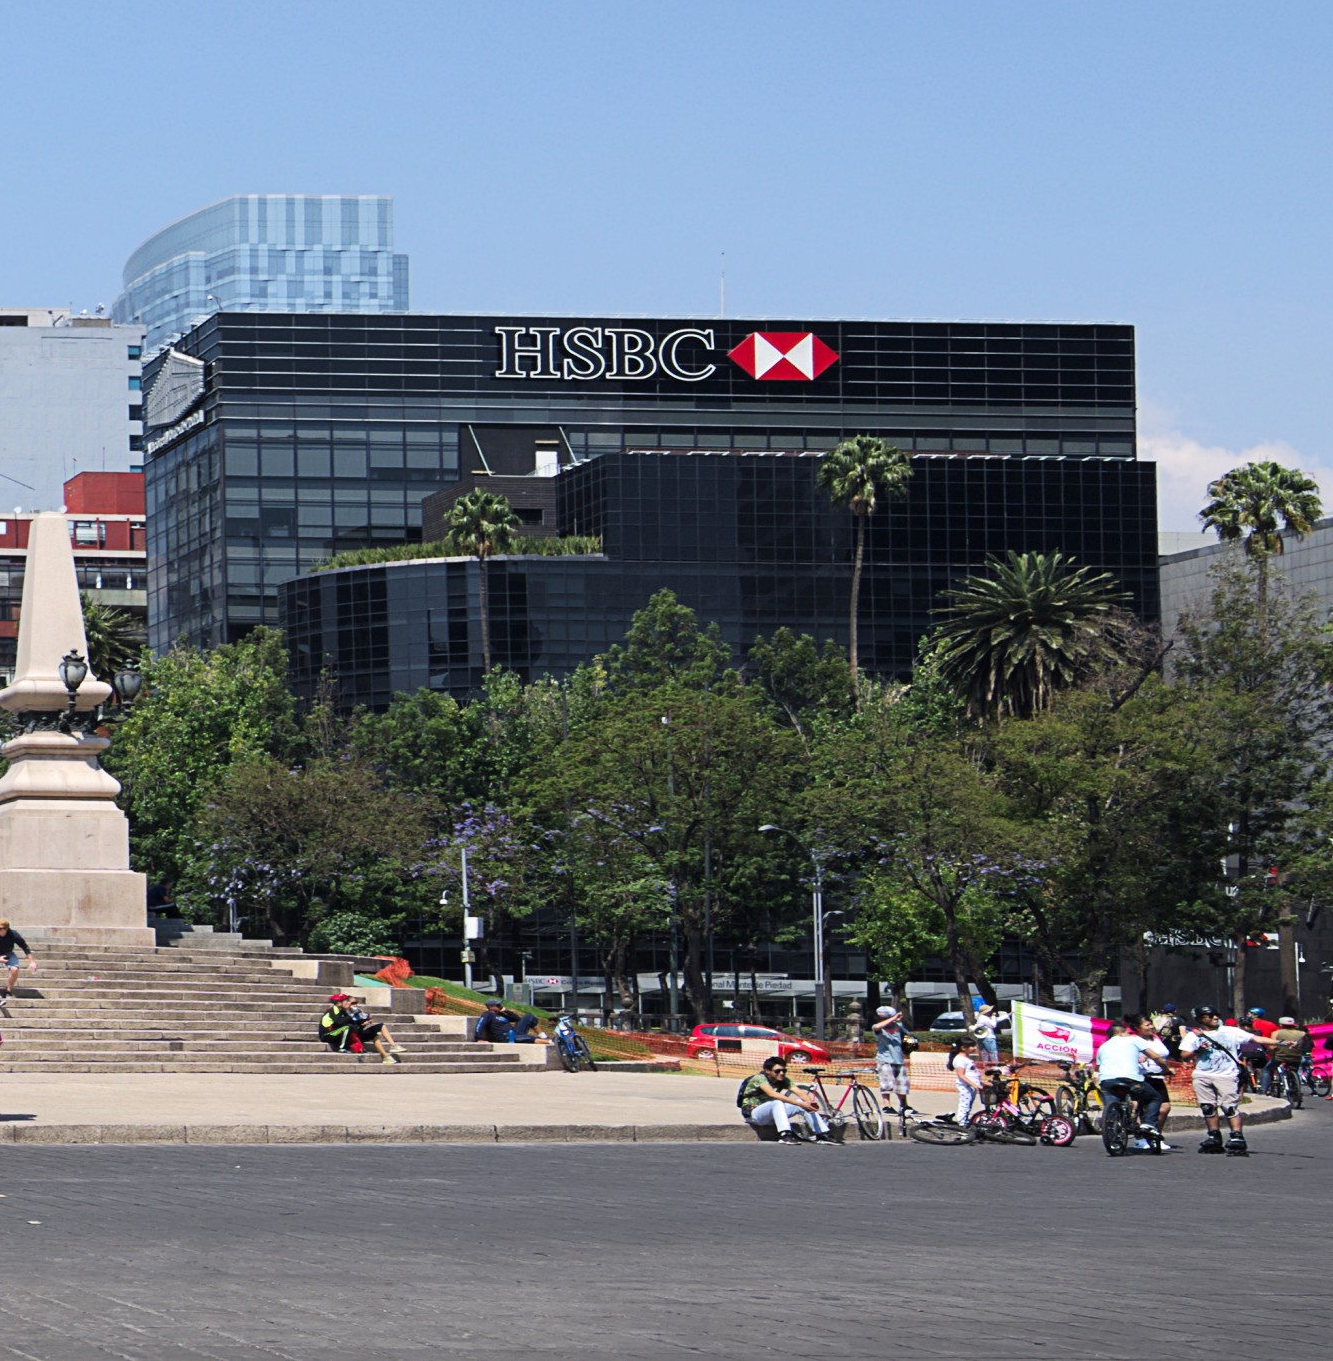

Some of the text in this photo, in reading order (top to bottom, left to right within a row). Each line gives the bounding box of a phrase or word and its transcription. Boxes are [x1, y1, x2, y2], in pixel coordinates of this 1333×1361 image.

[494, 326, 716, 382] HSBC
[726, 980, 751, 988] Mnte
[765, 981, 792, 989] Piedad
